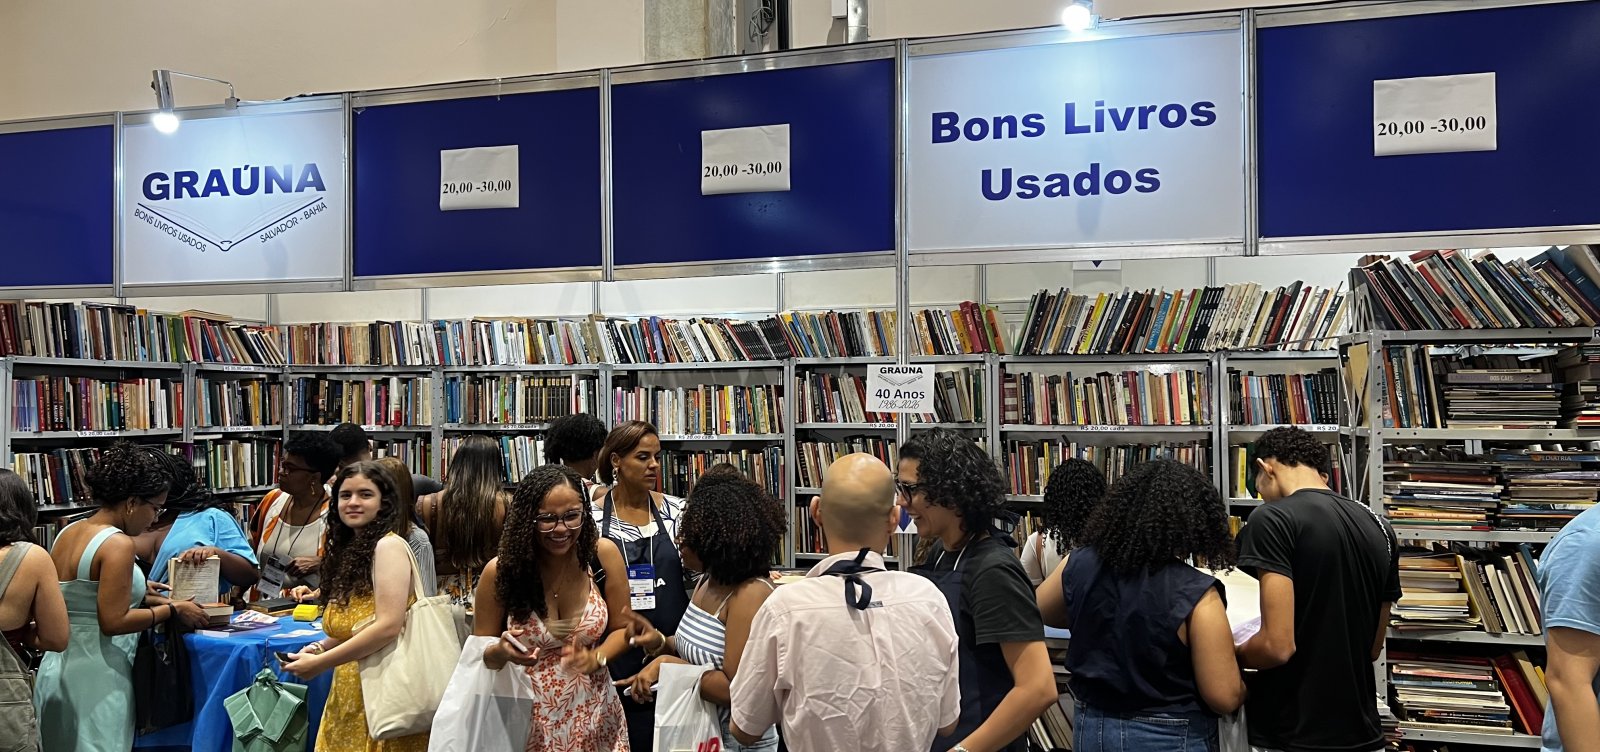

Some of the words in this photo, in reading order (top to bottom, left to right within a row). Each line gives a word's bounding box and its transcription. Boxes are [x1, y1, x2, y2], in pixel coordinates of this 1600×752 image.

[931, 110, 1046, 144] Bons
[1063, 99, 1218, 136] Livros
[1377, 119, 1425, 138] 20,00
[142, 163, 326, 201] GRAÚNA
[442, 182, 473, 194] 20,00
[704, 164, 738, 178] 20,00
[980, 162, 1161, 202] Usados
[134, 208, 153, 225] BONS
[153, 217, 178, 238] LIVROS
[178, 231, 207, 252] USADOS
[260, 216, 298, 243] SALVADOR
[303, 201, 328, 220] BAHIA
[875, 388, 891, 399] 40
[893, 388, 925, 399] Anos
